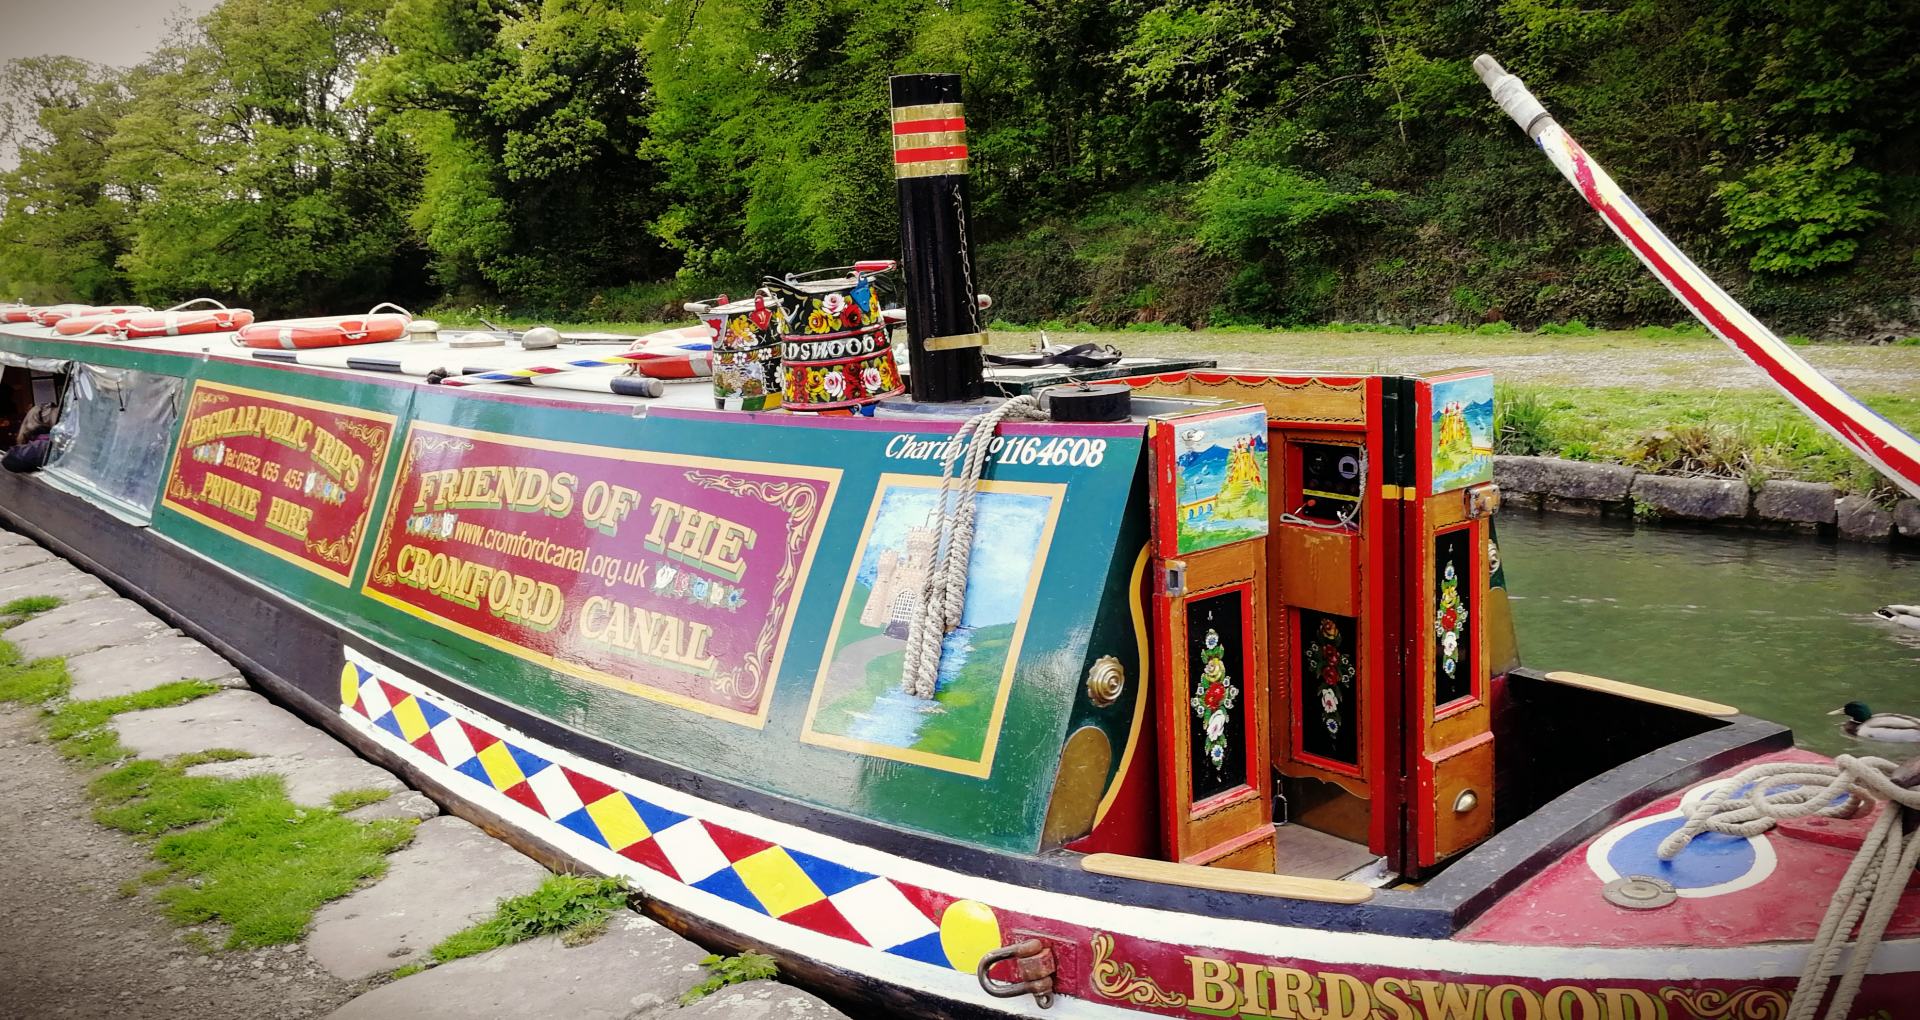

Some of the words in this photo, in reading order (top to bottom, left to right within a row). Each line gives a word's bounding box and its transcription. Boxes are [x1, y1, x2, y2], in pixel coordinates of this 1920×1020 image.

[187, 405, 257, 447] REGULAR
[254, 406, 313, 452] PUBLIC
[310, 426, 365, 492] TRIPS
[262, 460, 280, 482] 055
[283, 468, 304, 490] 455
[885, 434, 969, 467] Charity
[997, 437, 1107, 467] 1164608
[200, 472, 262, 521] PRIVATE
[265, 496, 314, 541] HIRE
[413, 466, 578, 518] FRIENDS
[582, 480, 641, 537] OF
[643, 497, 757, 583] THE
[454, 520, 650, 588] www.cromfordcanal.org.uk
[396, 543, 564, 633] CROMFORD
[579, 595, 718, 678] CANAL
[1183, 955, 1669, 1020] BIRDSWOOD
